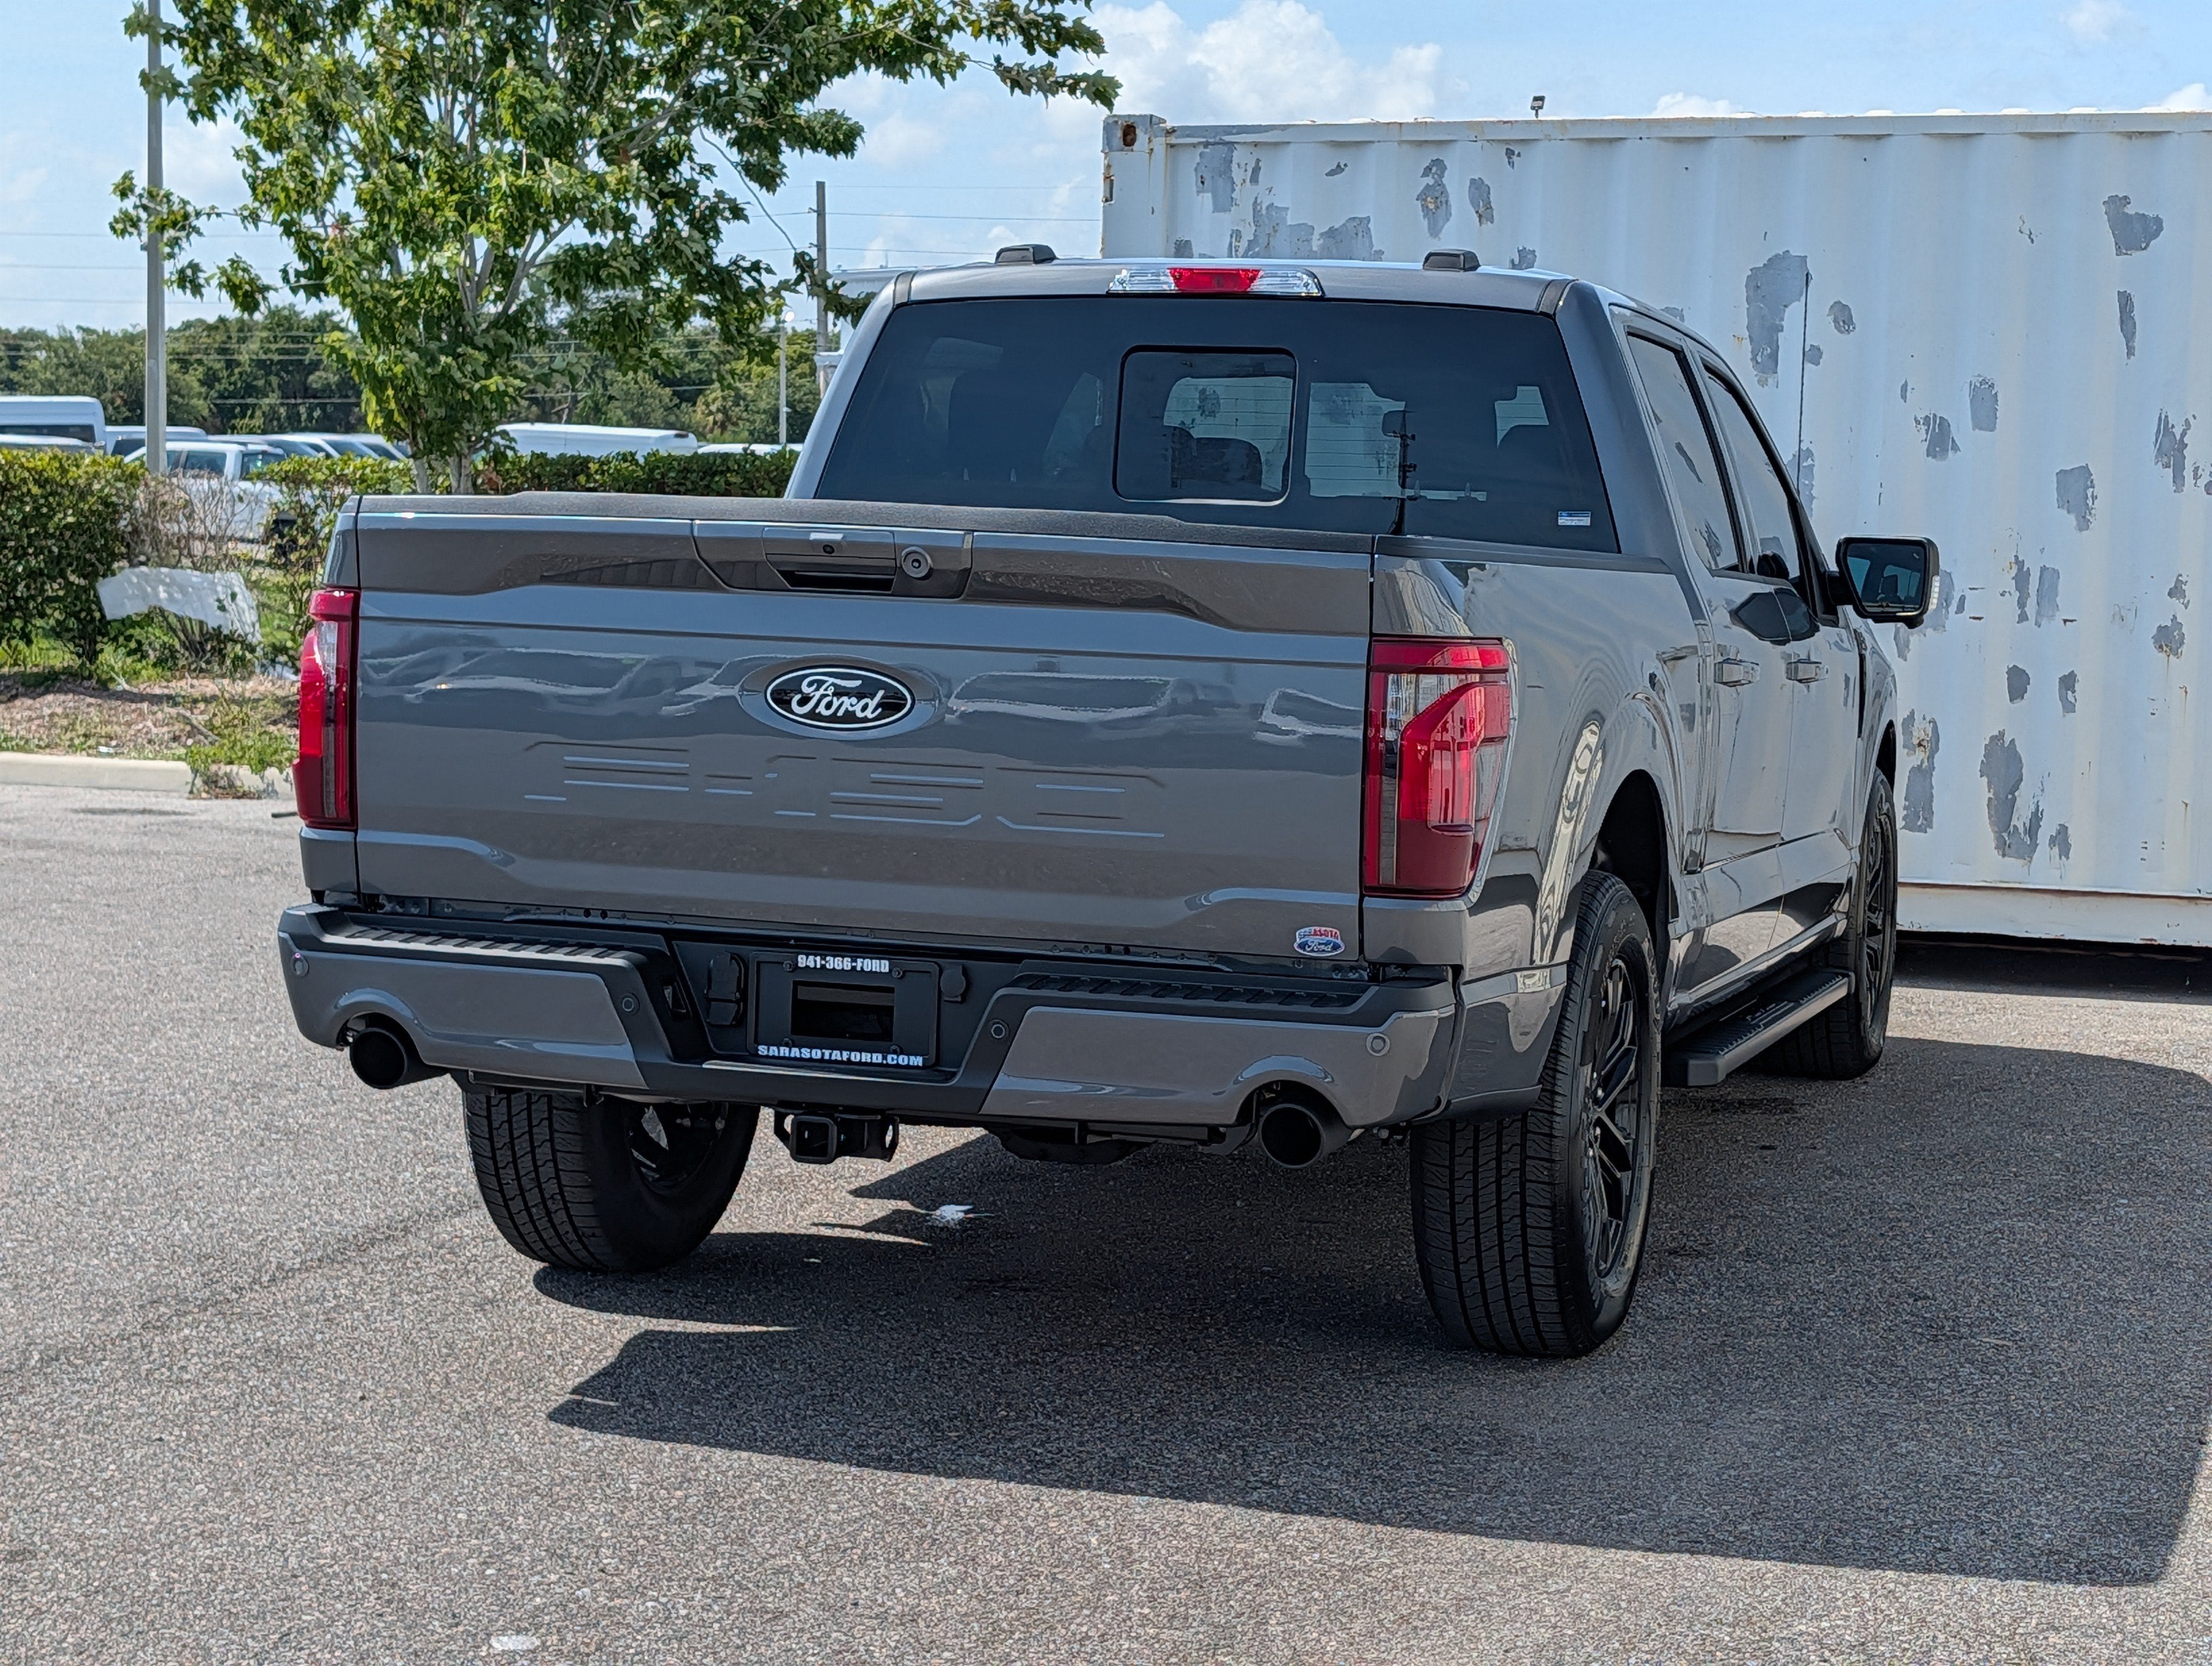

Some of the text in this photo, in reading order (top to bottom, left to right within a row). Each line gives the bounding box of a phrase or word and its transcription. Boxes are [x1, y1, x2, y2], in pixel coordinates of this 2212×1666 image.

[791, 676, 885, 719] Ford
[1305, 939, 1334, 951] Ford
[798, 954, 889, 972] 941-366-FORD
[758, 1045, 923, 1066] SARASOTAFORD.COM
